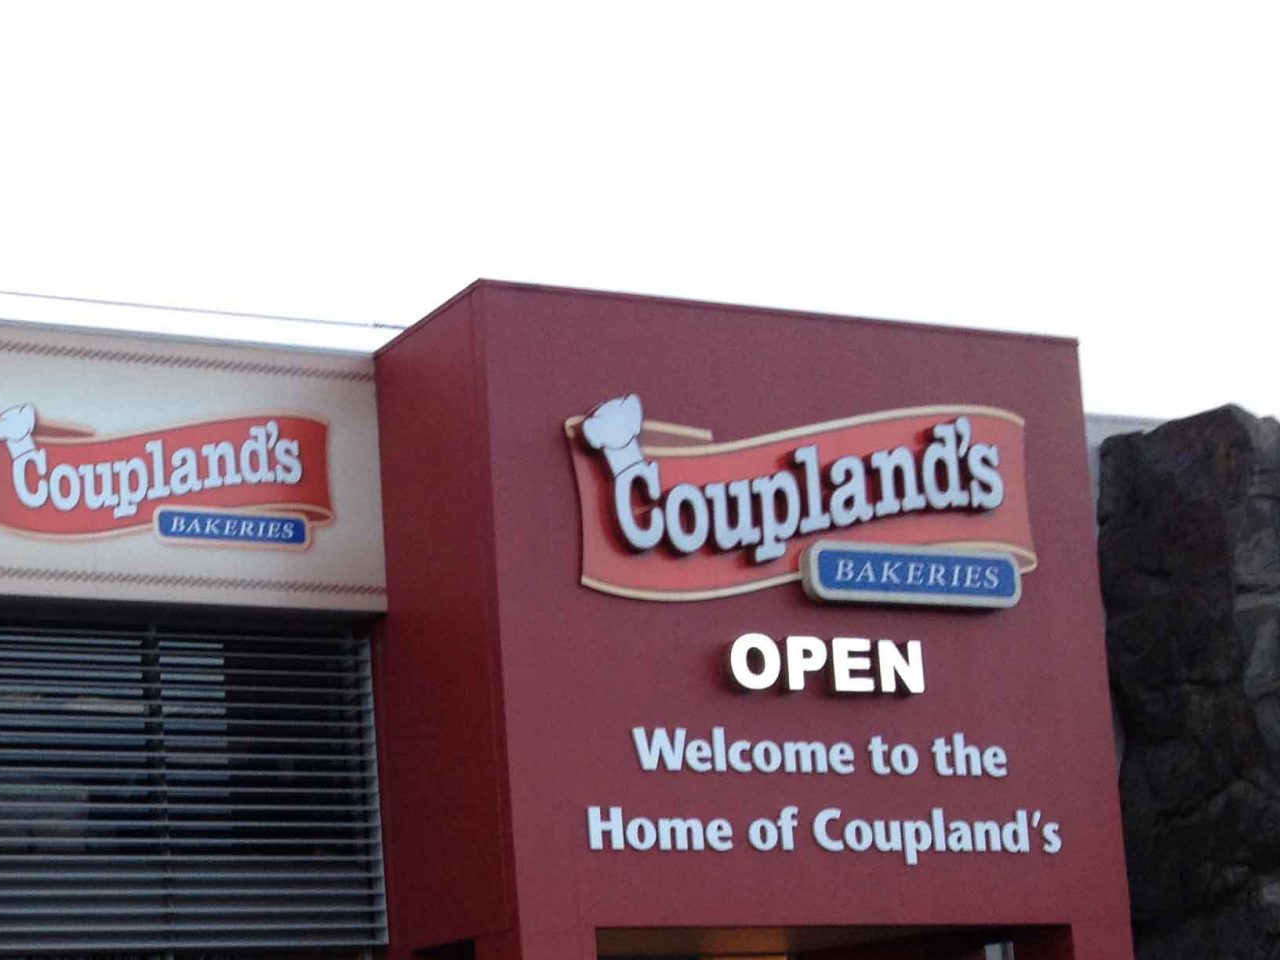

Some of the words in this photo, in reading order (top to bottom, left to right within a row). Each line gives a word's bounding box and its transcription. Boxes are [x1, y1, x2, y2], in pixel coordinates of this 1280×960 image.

[12, 420, 303, 519] Coupland's
[615, 417, 1004, 562] Coupland's
[170, 517, 295, 540] BAKERIES
[835, 558, 1001, 589] BAKERIES
[730, 632, 926, 694] OPEN
[632, 726, 855, 775] Welcome
[868, 735, 920, 775] to
[932, 733, 1008, 778] the
[587, 806, 733, 852] Home
[748, 806, 799, 851] of
[812, 807, 1062, 866] Coupland's
